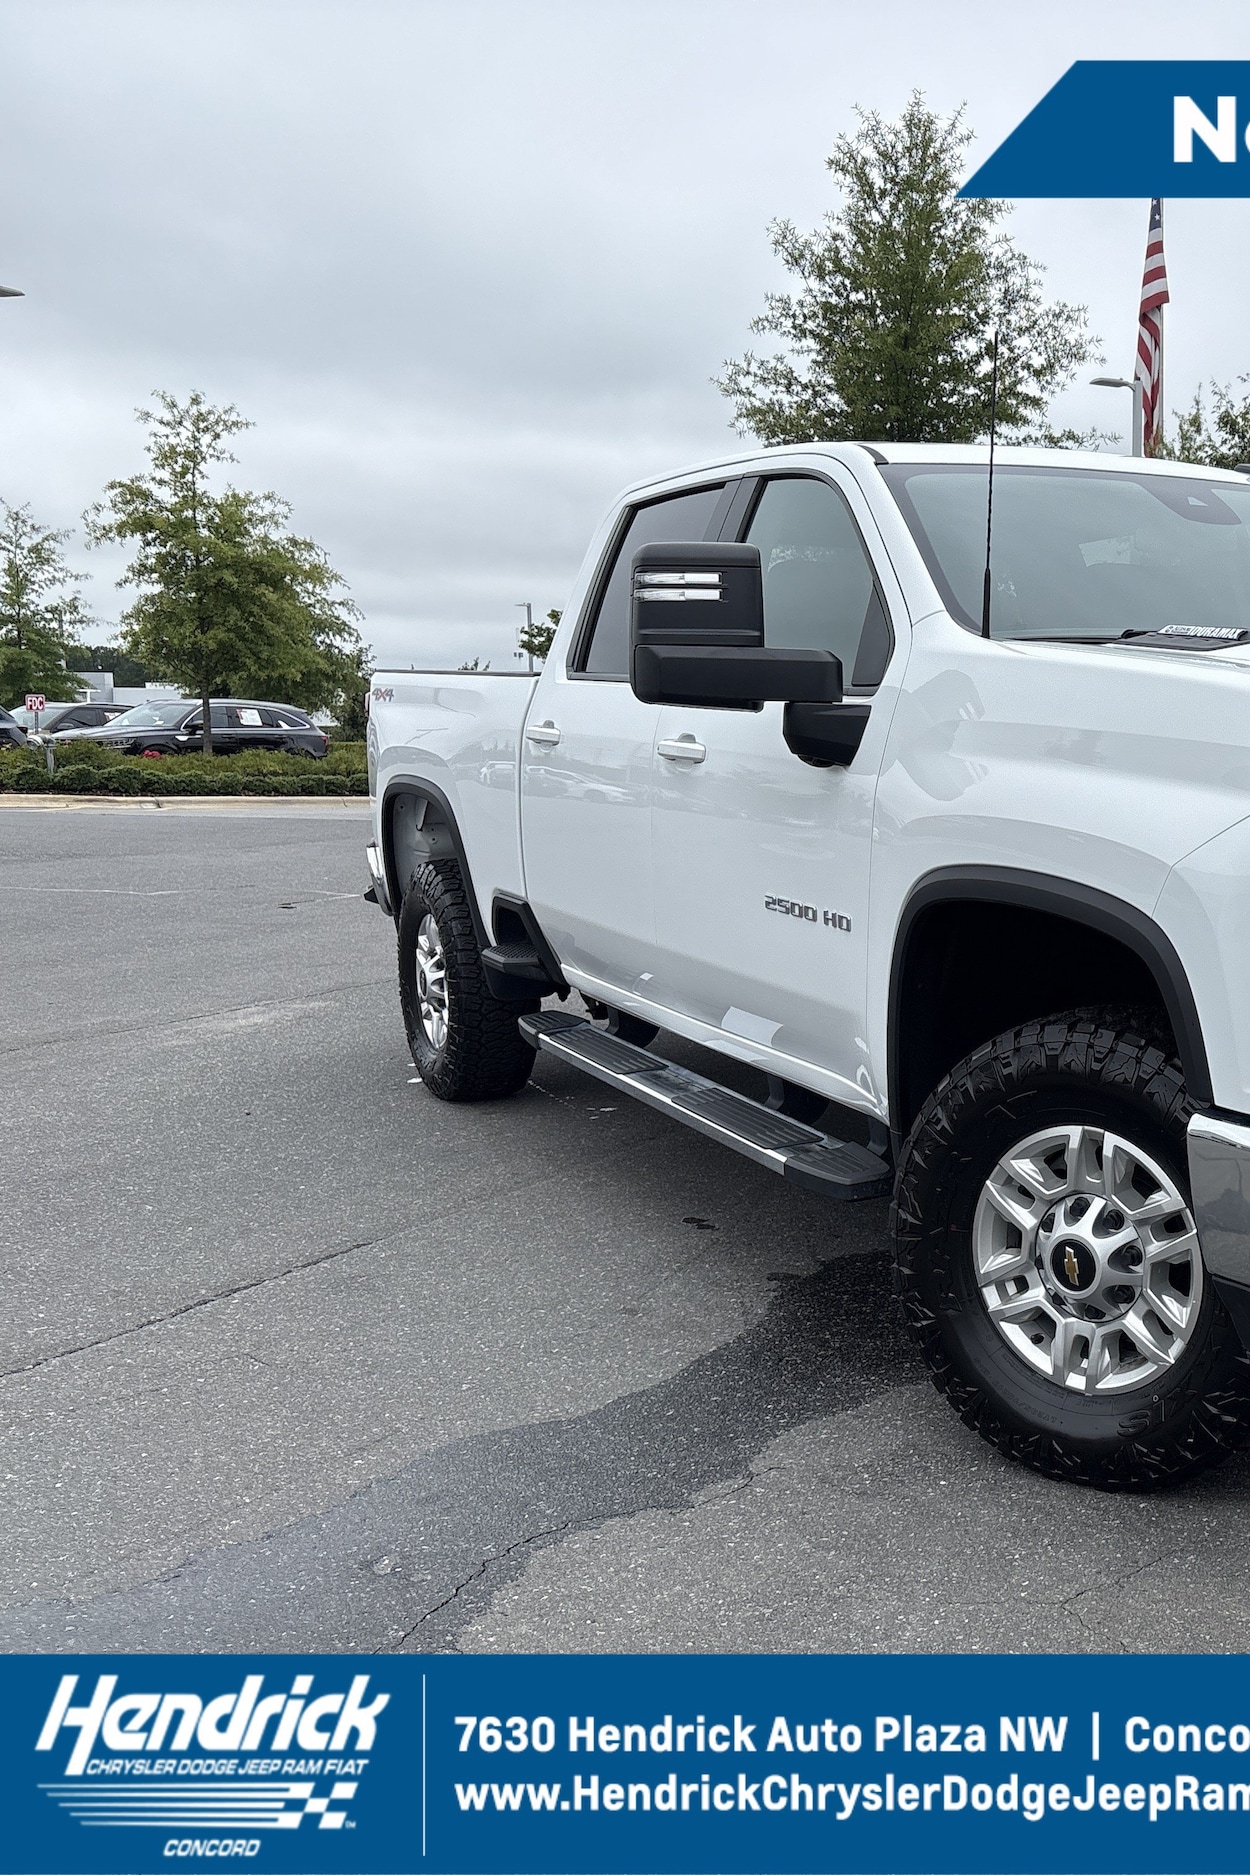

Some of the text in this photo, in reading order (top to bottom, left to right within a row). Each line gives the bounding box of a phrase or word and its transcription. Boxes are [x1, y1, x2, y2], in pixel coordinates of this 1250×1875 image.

[1190, 626, 1245, 639] DURAMAX
[27, 697, 44, 710] FDC
[764, 892, 852, 932] 2500 HD
